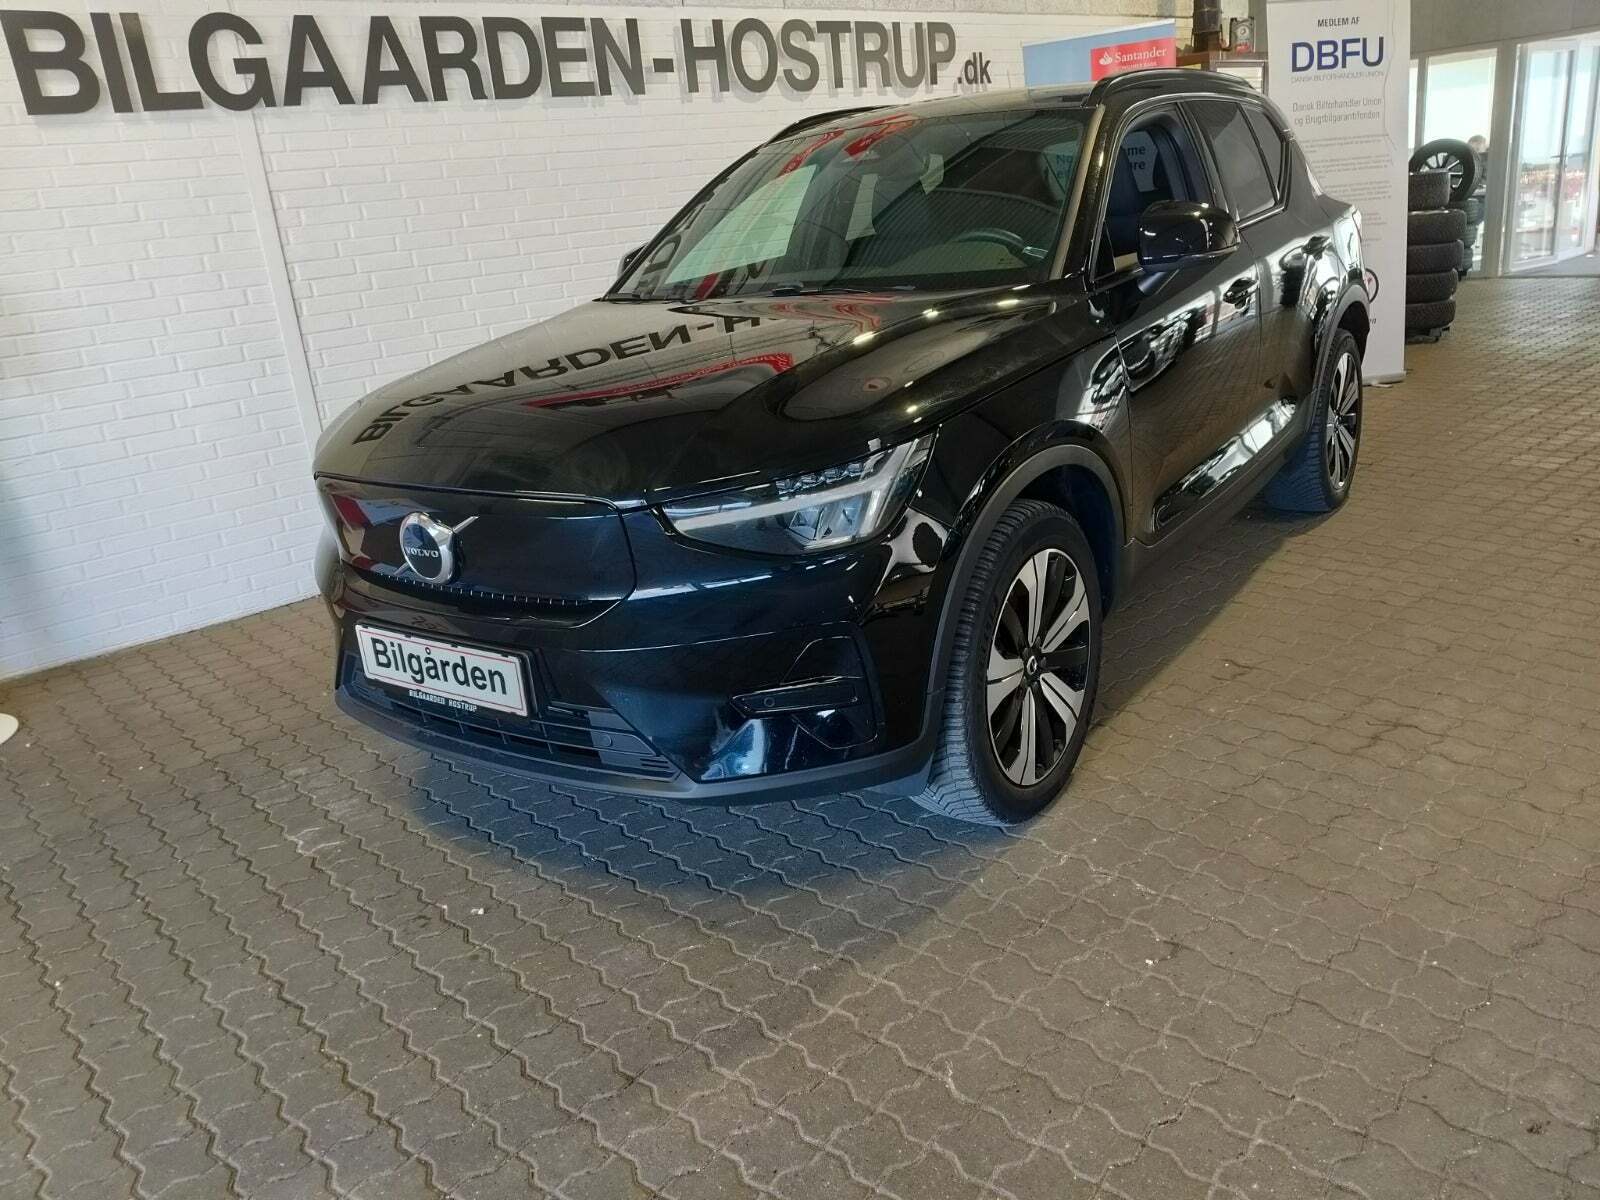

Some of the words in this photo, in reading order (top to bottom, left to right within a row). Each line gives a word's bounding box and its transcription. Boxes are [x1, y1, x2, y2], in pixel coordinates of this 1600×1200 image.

[1317, 17, 1349, 27] MEDLEM
[1351, 16, 1360, 24] AF
[1115, 47, 1168, 62] Santander
[1291, 36, 1384, 73] DBFU
[1292, 101, 1315, 113] Dansk
[1362, 96, 1382, 107] Union
[404, 546, 439, 558] VOLVO
[371, 637, 507, 695] Bilgården
[409, 689, 445, 705] BILGAARDEN
[448, 699, 477, 713] HOSTRUP
